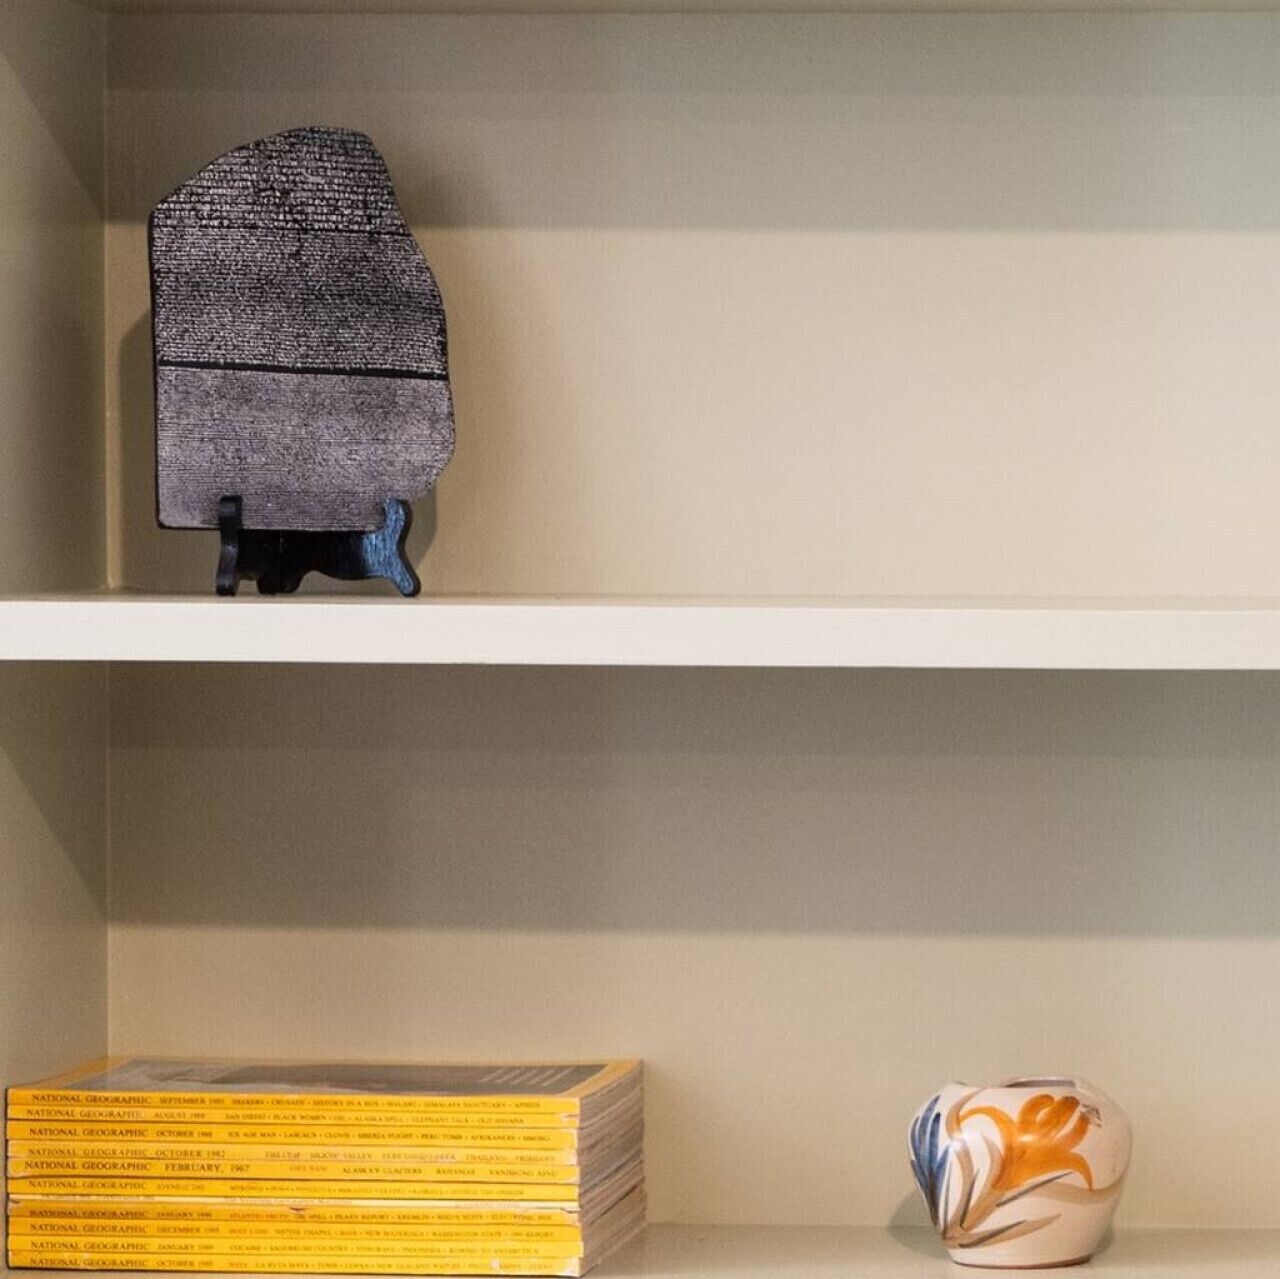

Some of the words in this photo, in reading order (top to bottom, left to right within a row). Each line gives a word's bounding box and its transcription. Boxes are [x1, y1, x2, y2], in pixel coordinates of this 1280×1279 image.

[32, 1094, 80, 1103] NATIONAL
[86, 1095, 150, 1104] GEOGRAPHIC
[27, 1109, 75, 1118] NATIONAL
[79, 1110, 146, 1119] GEOGRAPHIC
[29, 1128, 77, 1137] NATIONAL
[82, 1129, 146, 1138] GEOGRAPHIC
[28, 1148, 76, 1157] NATIONAL
[83, 1149, 147, 1158] GEOGRAPHIC
[155, 1150, 201, 1158] OCTOBER
[25, 1160, 76, 1170] NATIONAL
[82, 1161, 150, 1171] GEOGRAPHIC
[28, 1179, 77, 1189] NATIONAL
[82, 1181, 147, 1190] GEOGRAPHIC
[29, 1209, 78, 1218] NATIONAL
[30, 1223, 77, 1232] NATIONAL
[82, 1224, 148, 1233] GEOGRAPHIC
[31, 1241, 79, 1250] NATIONAL
[83, 1242, 149, 1251] GEOGRAPHIC
[30, 1256, 79, 1266] NATIONAL
[83, 1258, 149, 1267] GEOGRAPHIC
